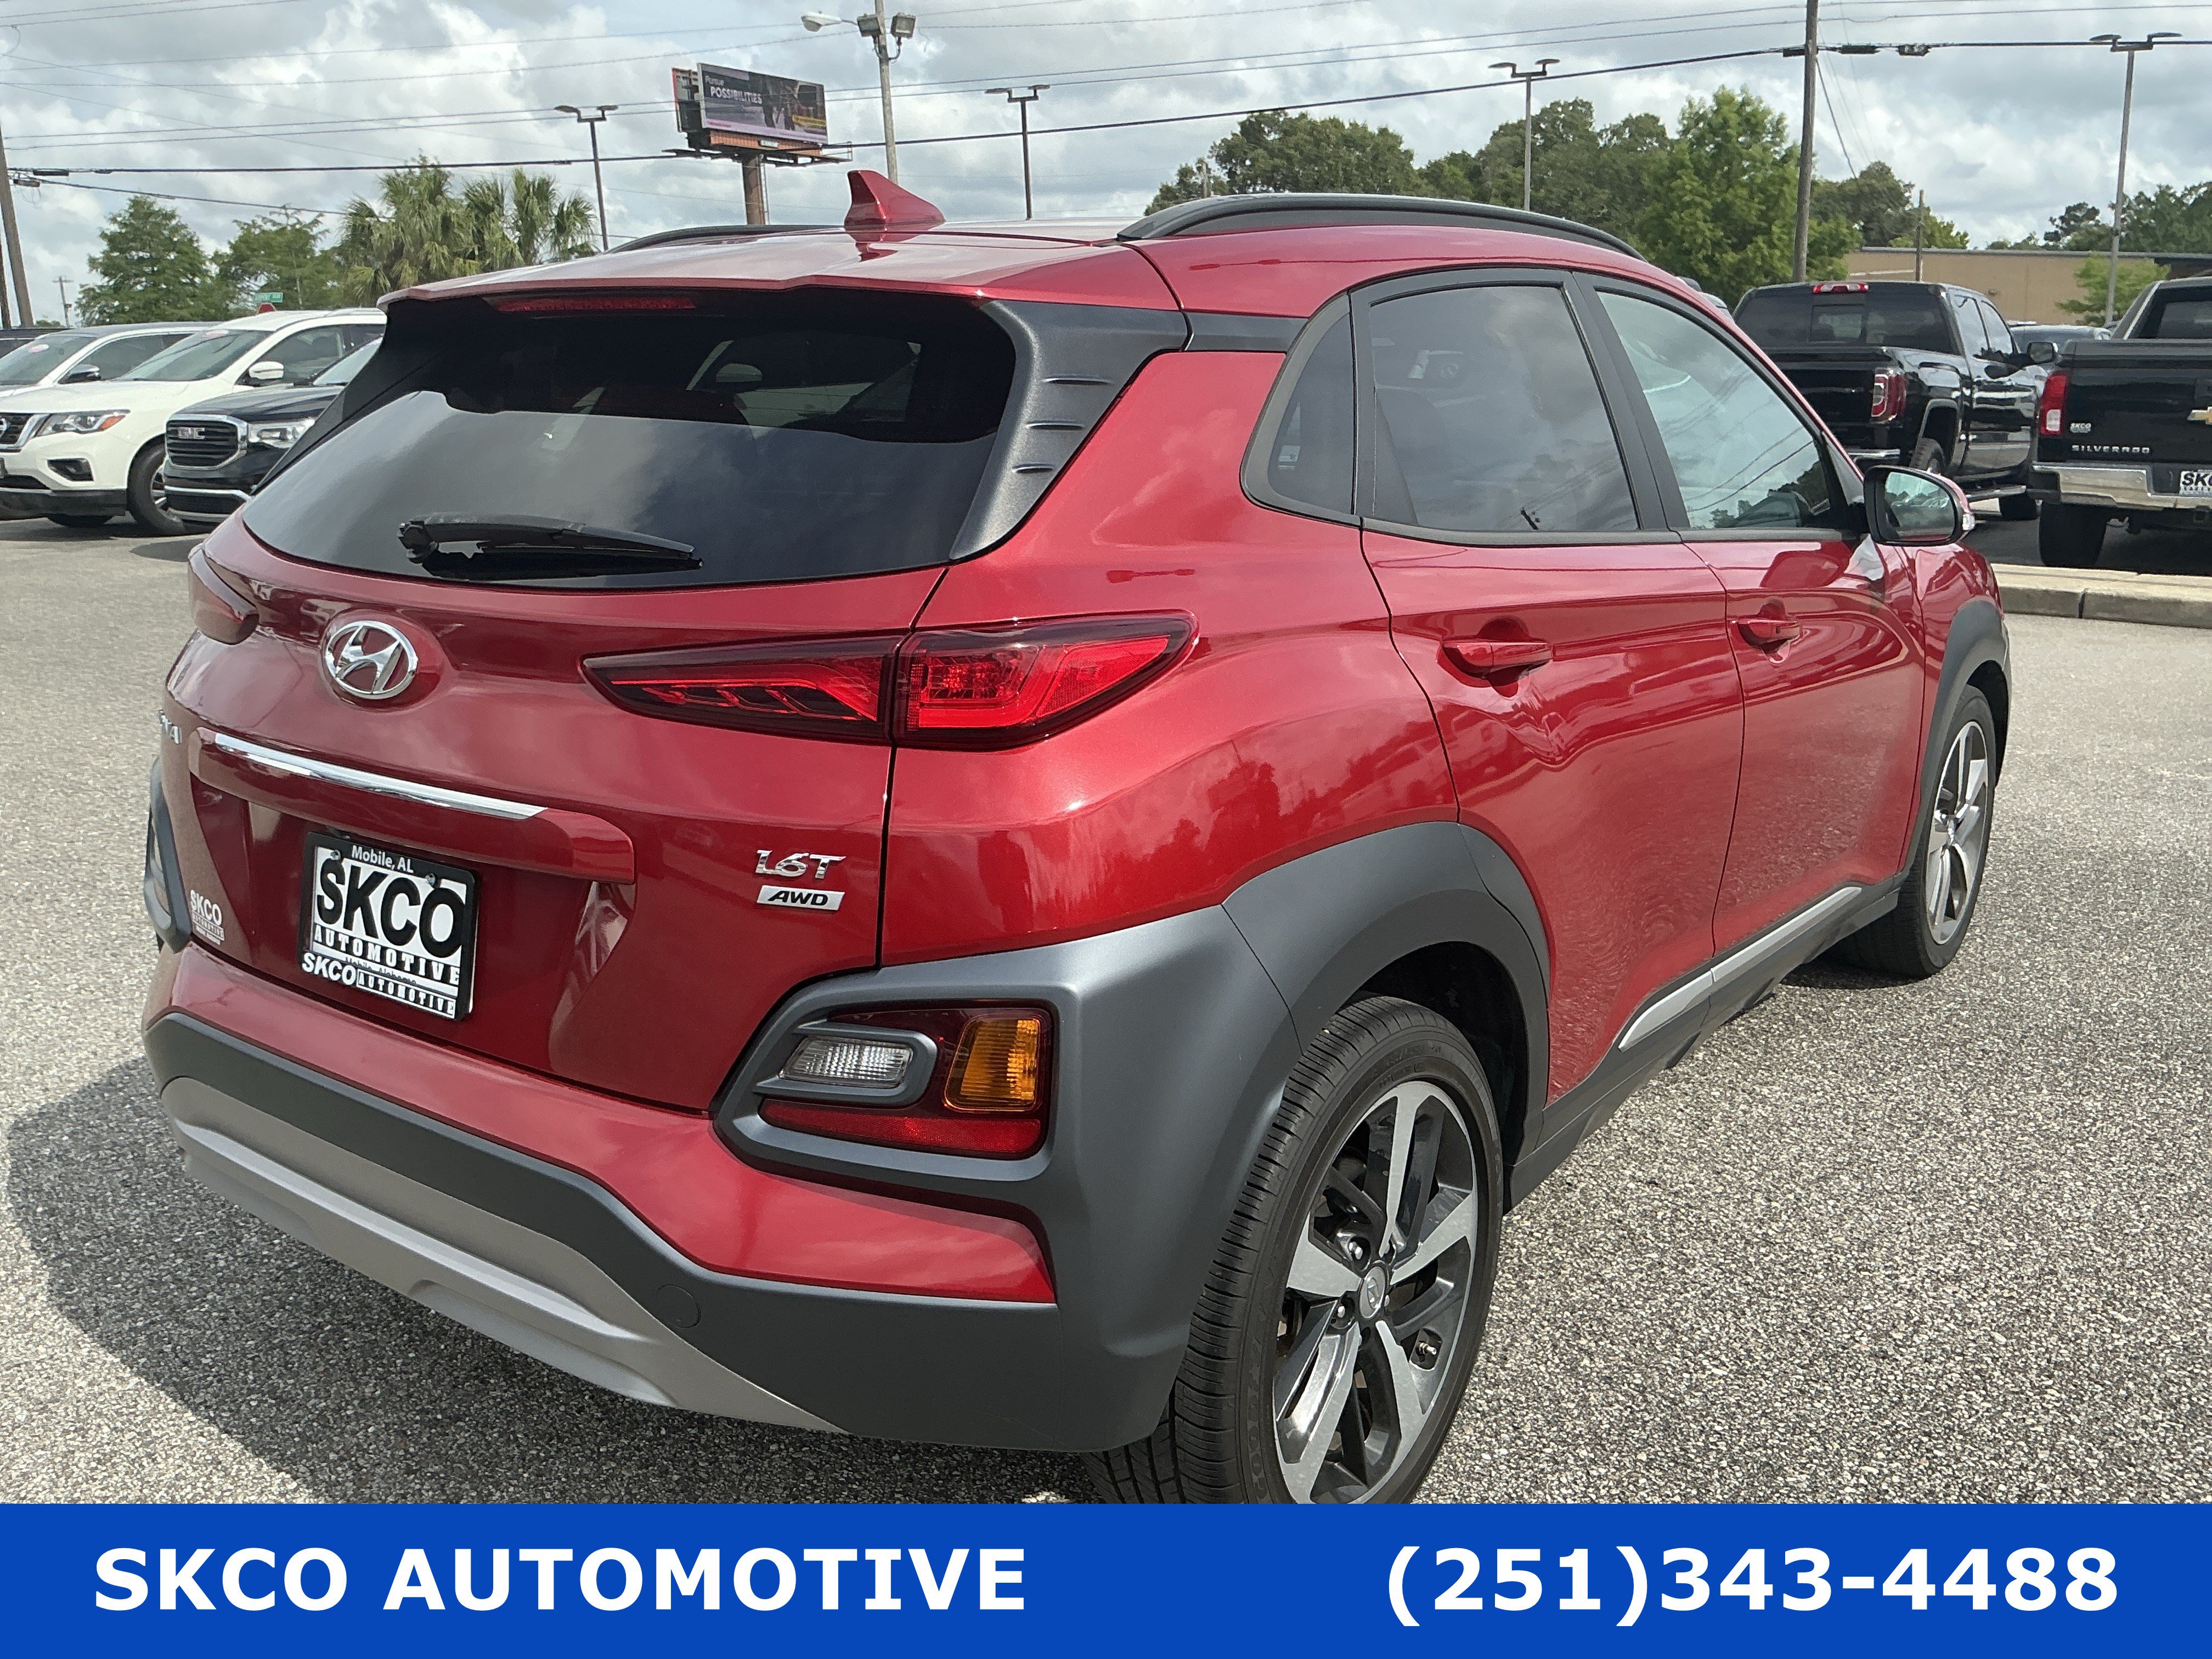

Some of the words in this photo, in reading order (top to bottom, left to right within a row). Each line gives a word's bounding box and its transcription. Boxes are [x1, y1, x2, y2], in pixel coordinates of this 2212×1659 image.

[710, 86, 763, 105] POSSIBILITIES
[351, 844, 395, 870] Mobile,
[397, 856, 414, 873] AL
[190, 889, 222, 926] SKCO
[317, 857, 467, 958] SKCO
[768, 890, 828, 906] AWD
[314, 923, 460, 986] AUTOMOTIVE
[302, 952, 357, 986] SKCO
[358, 970, 455, 1015] AUTOMOTIVE
